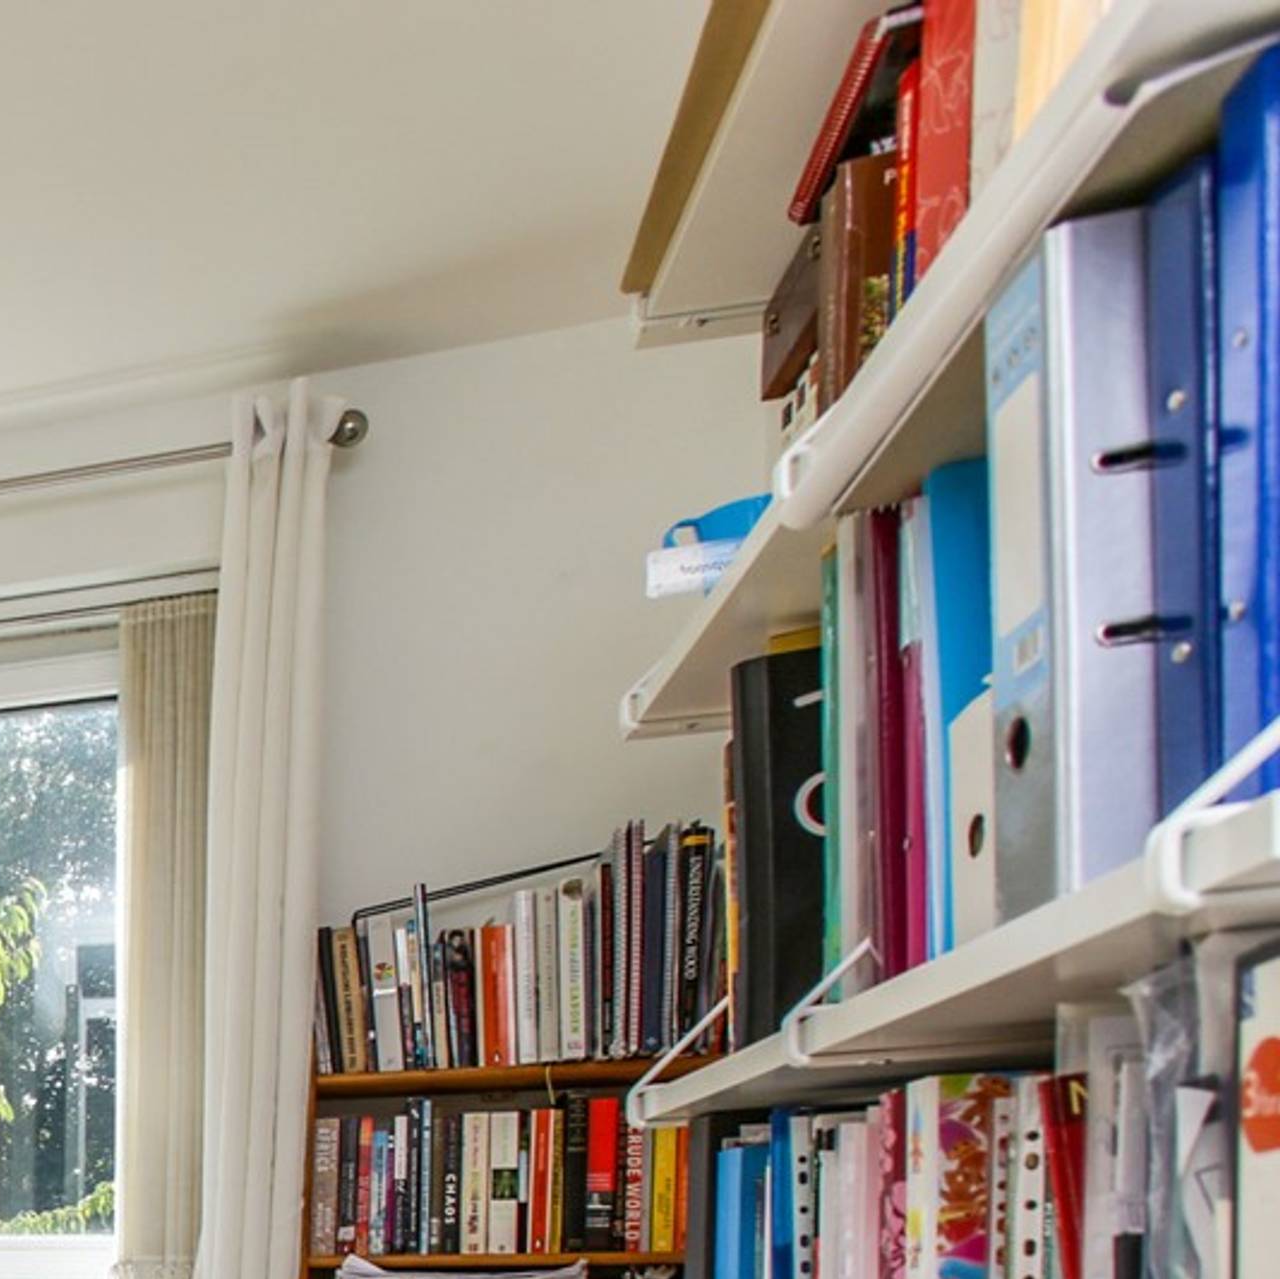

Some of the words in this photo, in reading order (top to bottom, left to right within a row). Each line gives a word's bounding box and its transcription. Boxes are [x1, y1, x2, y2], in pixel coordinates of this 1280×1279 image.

[685, 855, 703, 944] UNDERSTANDING
[684, 945, 698, 980] WOOD
[627, 1127, 644, 1179] CRUDE
[444, 1172, 457, 1225] CHAOS
[625, 1182, 642, 1242] WORLD
